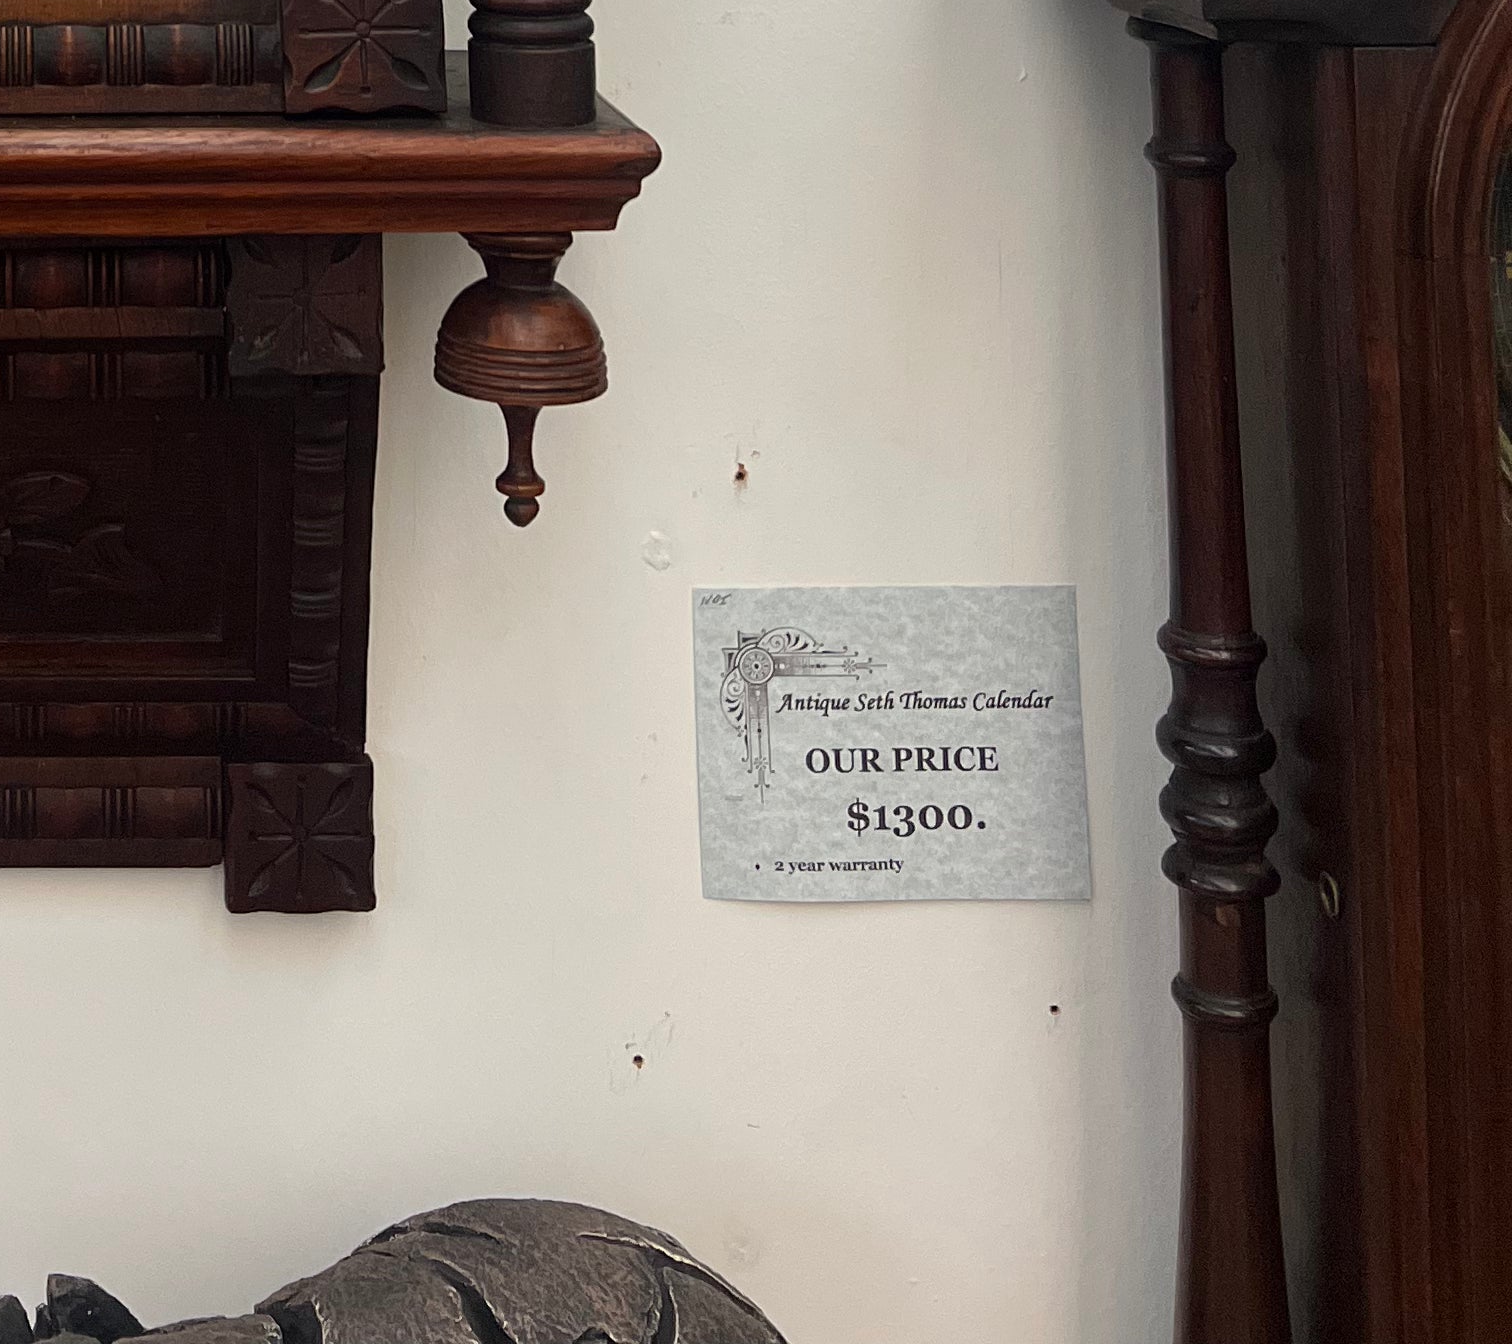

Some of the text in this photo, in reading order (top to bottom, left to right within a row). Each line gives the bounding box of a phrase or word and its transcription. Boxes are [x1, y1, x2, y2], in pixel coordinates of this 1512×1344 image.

[776, 690, 1053, 717] Antique Seth Thomas Calendar
[806, 747, 998, 773] OUR PRICE
[848, 798, 985, 837] $1300.
[775, 859, 904, 874] 2 year warranty
